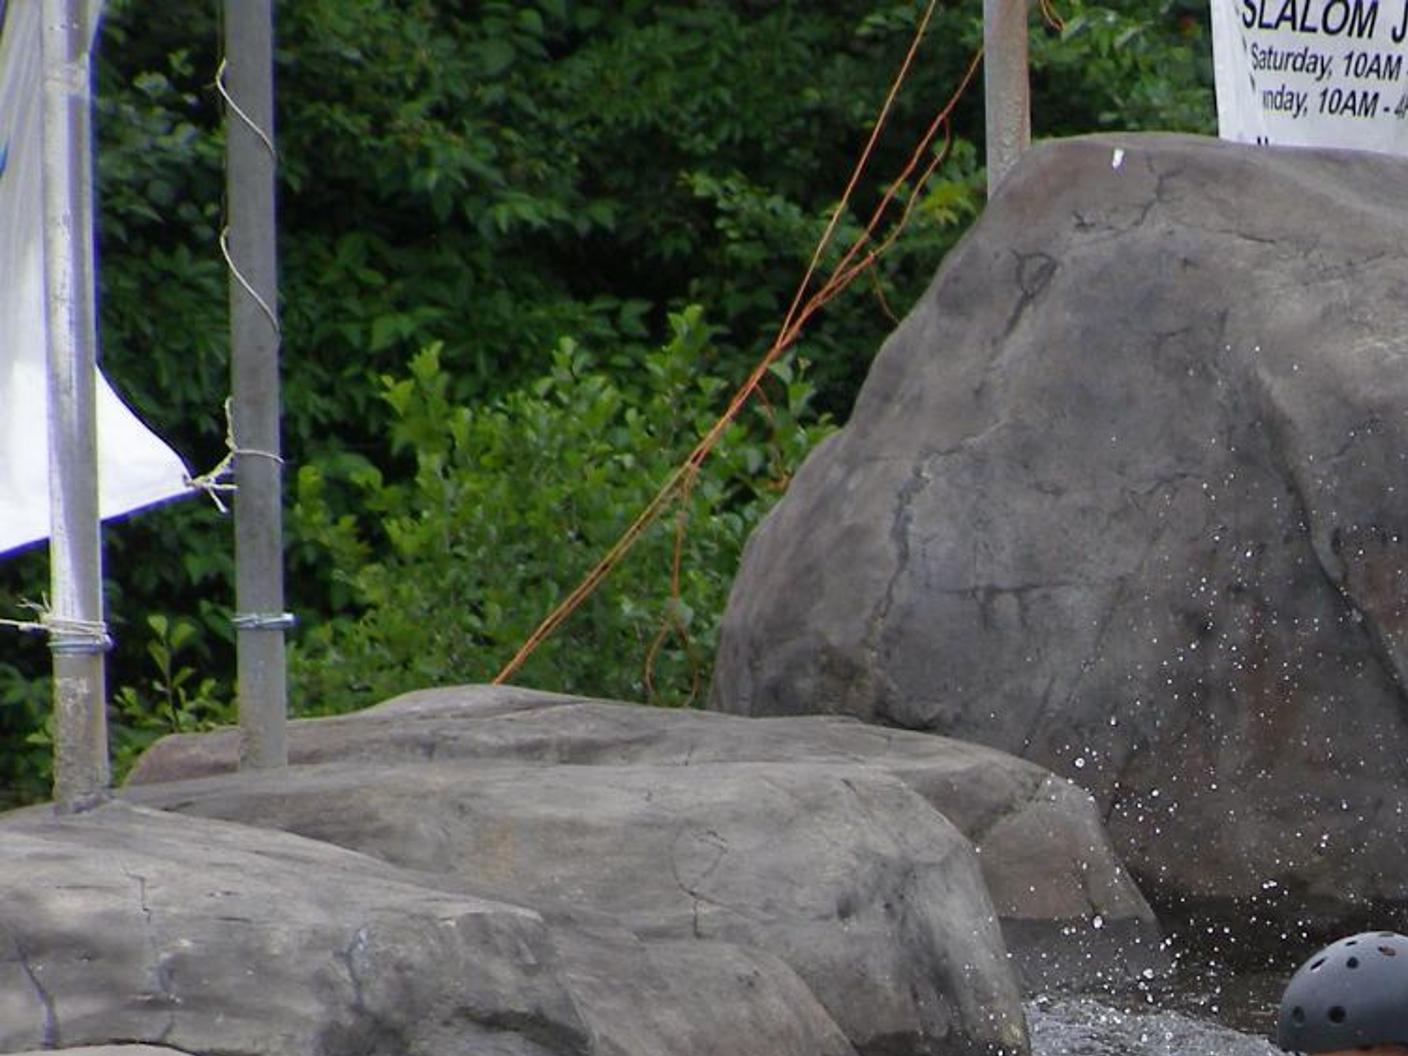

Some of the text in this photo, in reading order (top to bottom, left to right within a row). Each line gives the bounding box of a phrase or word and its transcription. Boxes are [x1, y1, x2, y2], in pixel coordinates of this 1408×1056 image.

[1241, 0, 1379, 39] SLALOM
[1251, 42, 1333, 82] Saturday,
[1343, 49, 1402, 81] 10AM
[1262, 84, 1308, 119] nday,
[1319, 87, 1379, 118] 10AM
